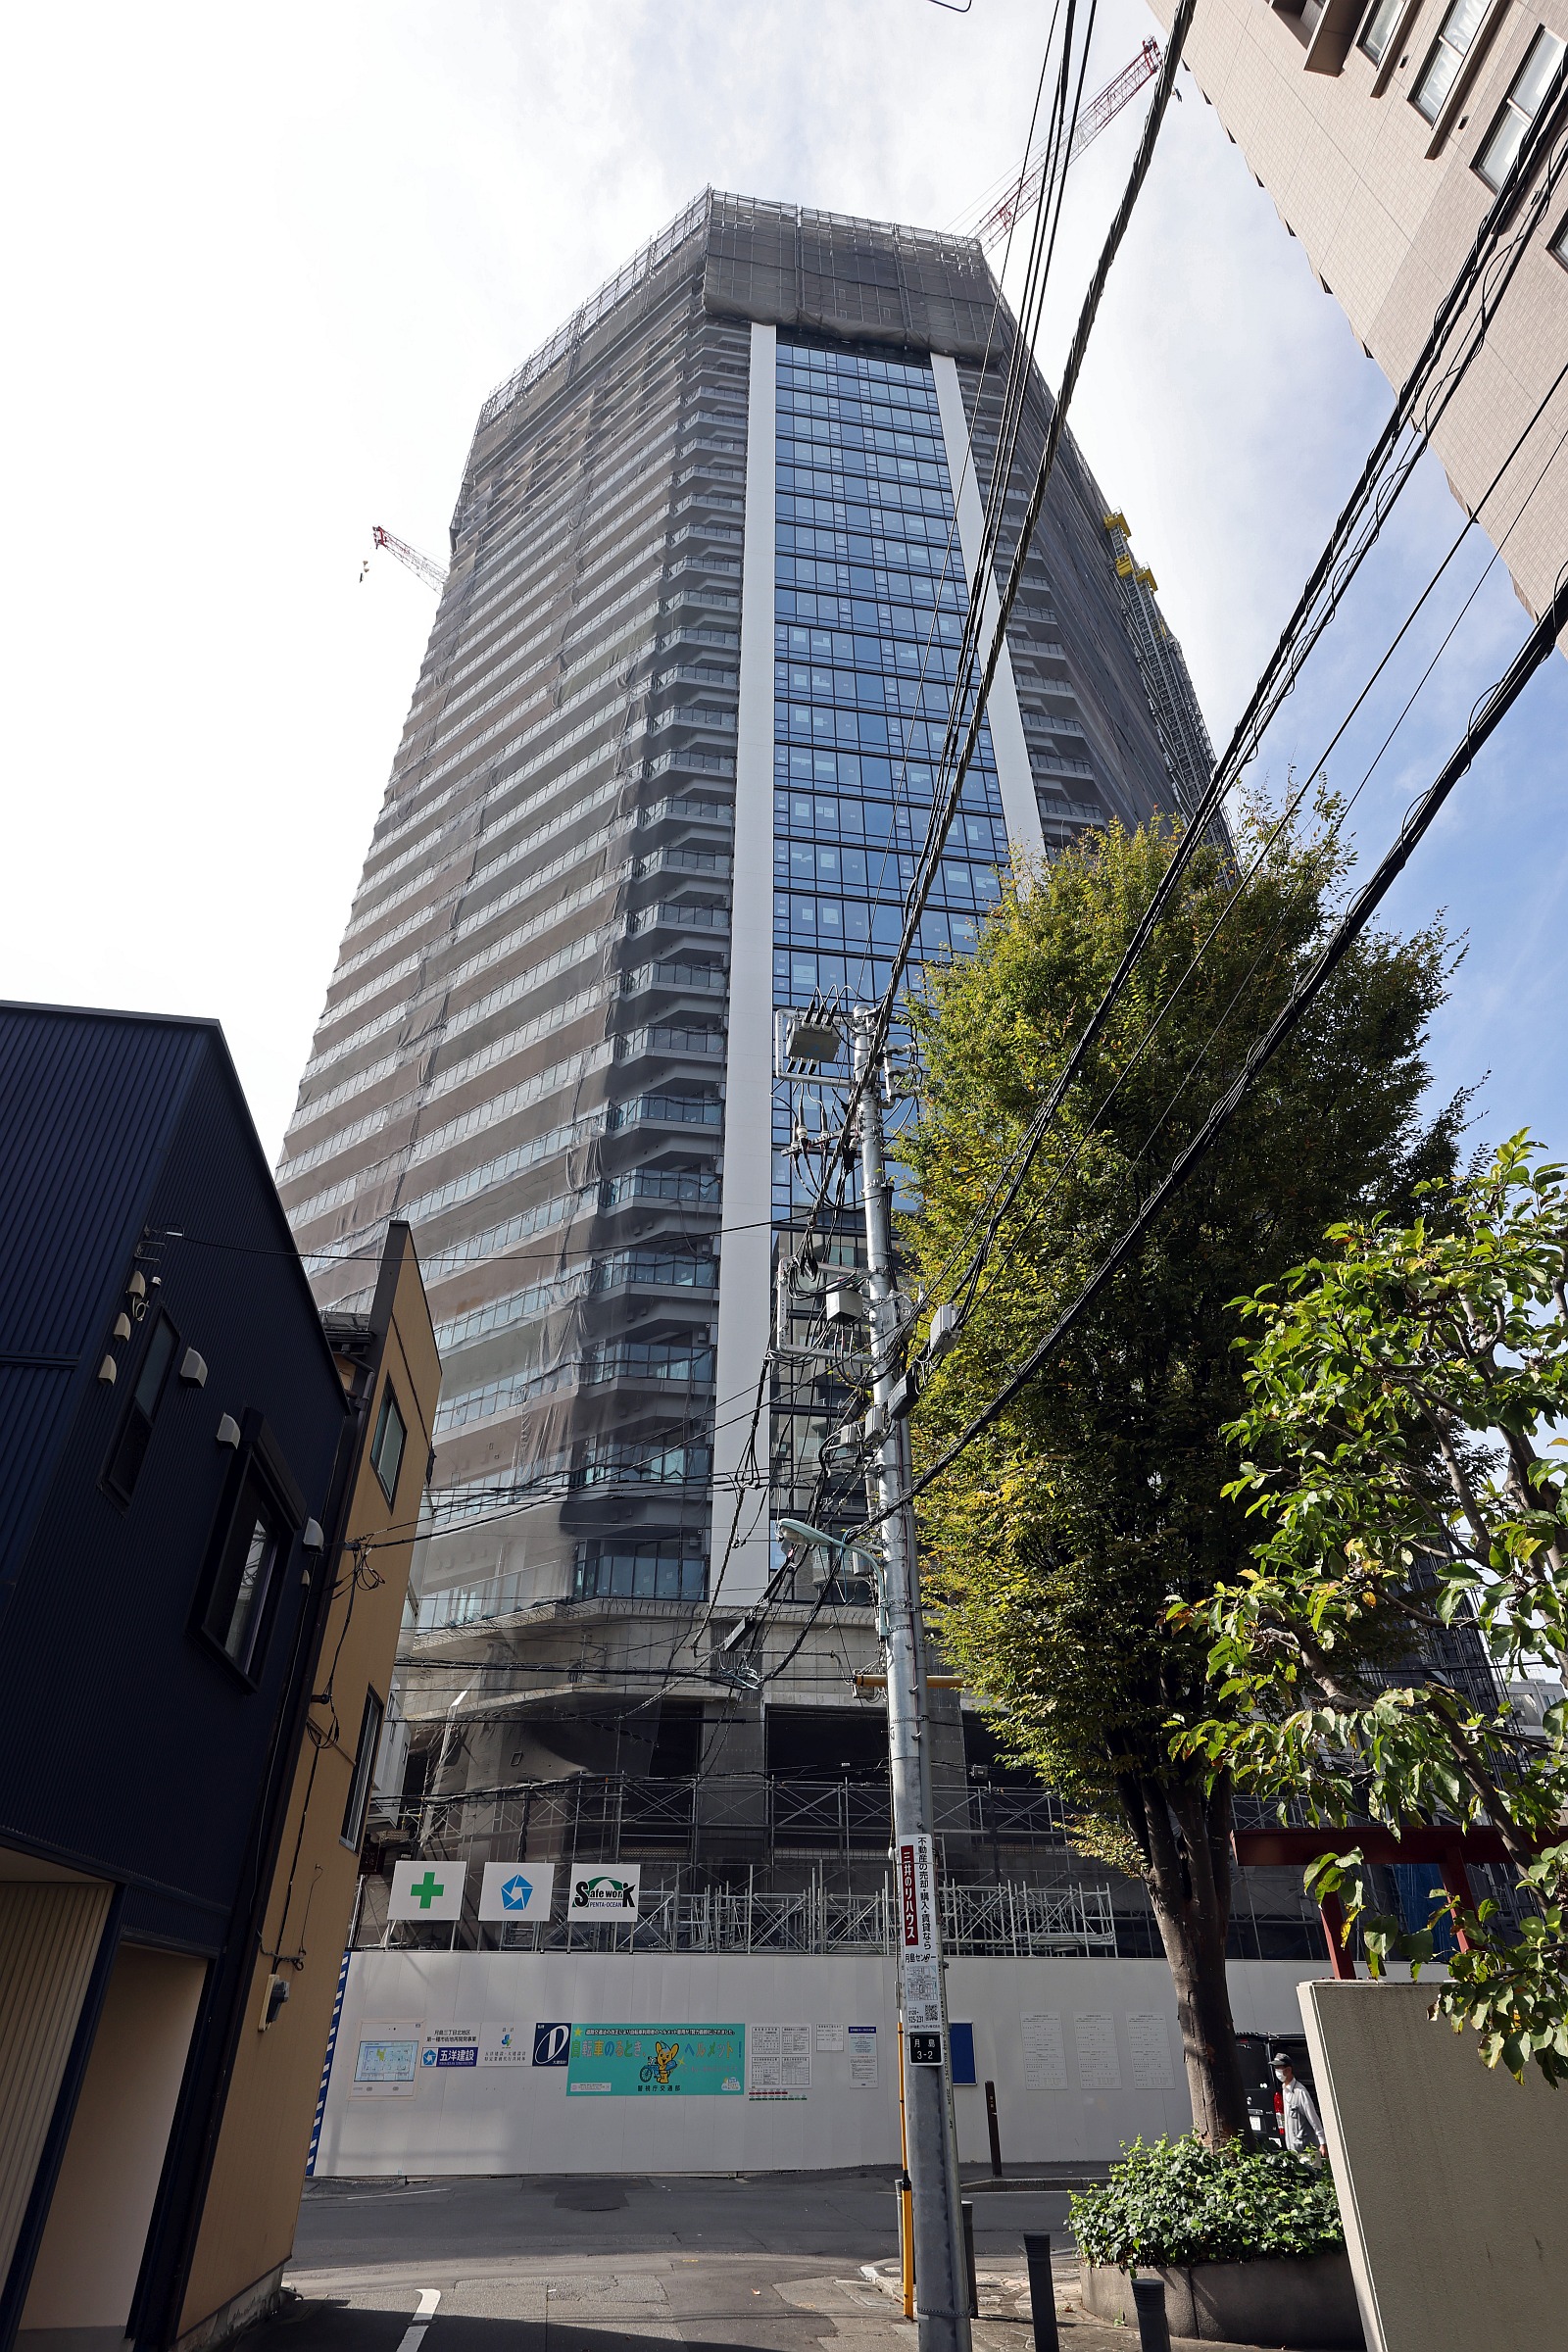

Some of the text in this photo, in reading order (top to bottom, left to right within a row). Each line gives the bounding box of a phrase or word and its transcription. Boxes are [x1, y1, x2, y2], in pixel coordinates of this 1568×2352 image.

[574, 1881, 605, 1907] Safe
[903, 1851, 915, 1939] 三井のリハウス
[917, 1837, 931, 1950] 不動産の売却・購入・賃貸なら
[913, 2038, 936, 2048] 月島
[439, 2049, 475, 2062] 五洋建設
[916, 2050, 933, 2060] 3-2
